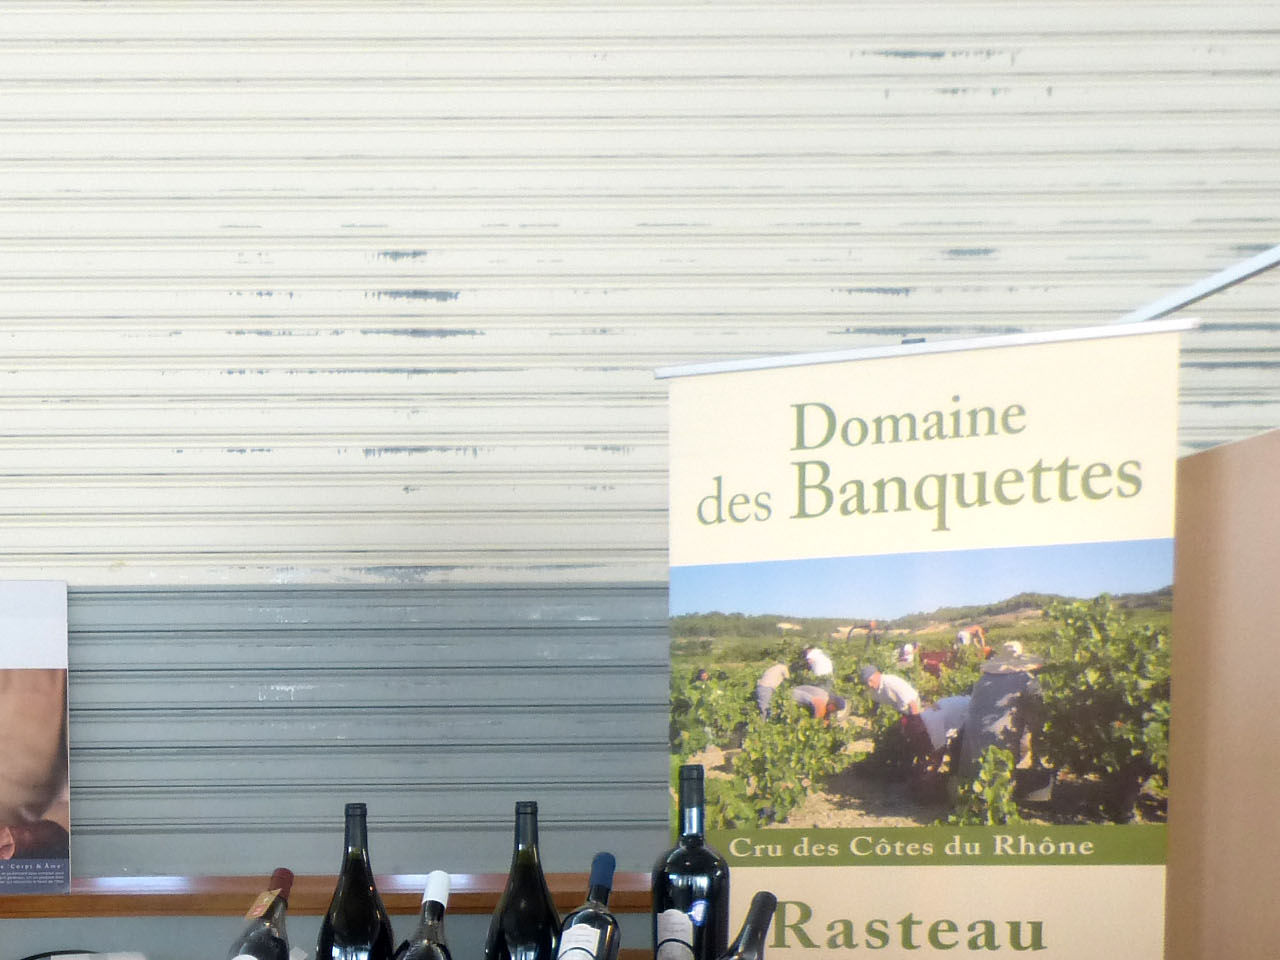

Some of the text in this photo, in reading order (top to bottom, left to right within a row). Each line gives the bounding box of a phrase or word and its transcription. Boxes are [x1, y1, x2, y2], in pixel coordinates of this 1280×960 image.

[789, 395, 1026, 451] Domaine
[697, 457, 1143, 532] des Banquettes
[729, 834, 1095, 858] Cru des Côtes du Rhône
[768, 901, 1048, 951] Rasteau
